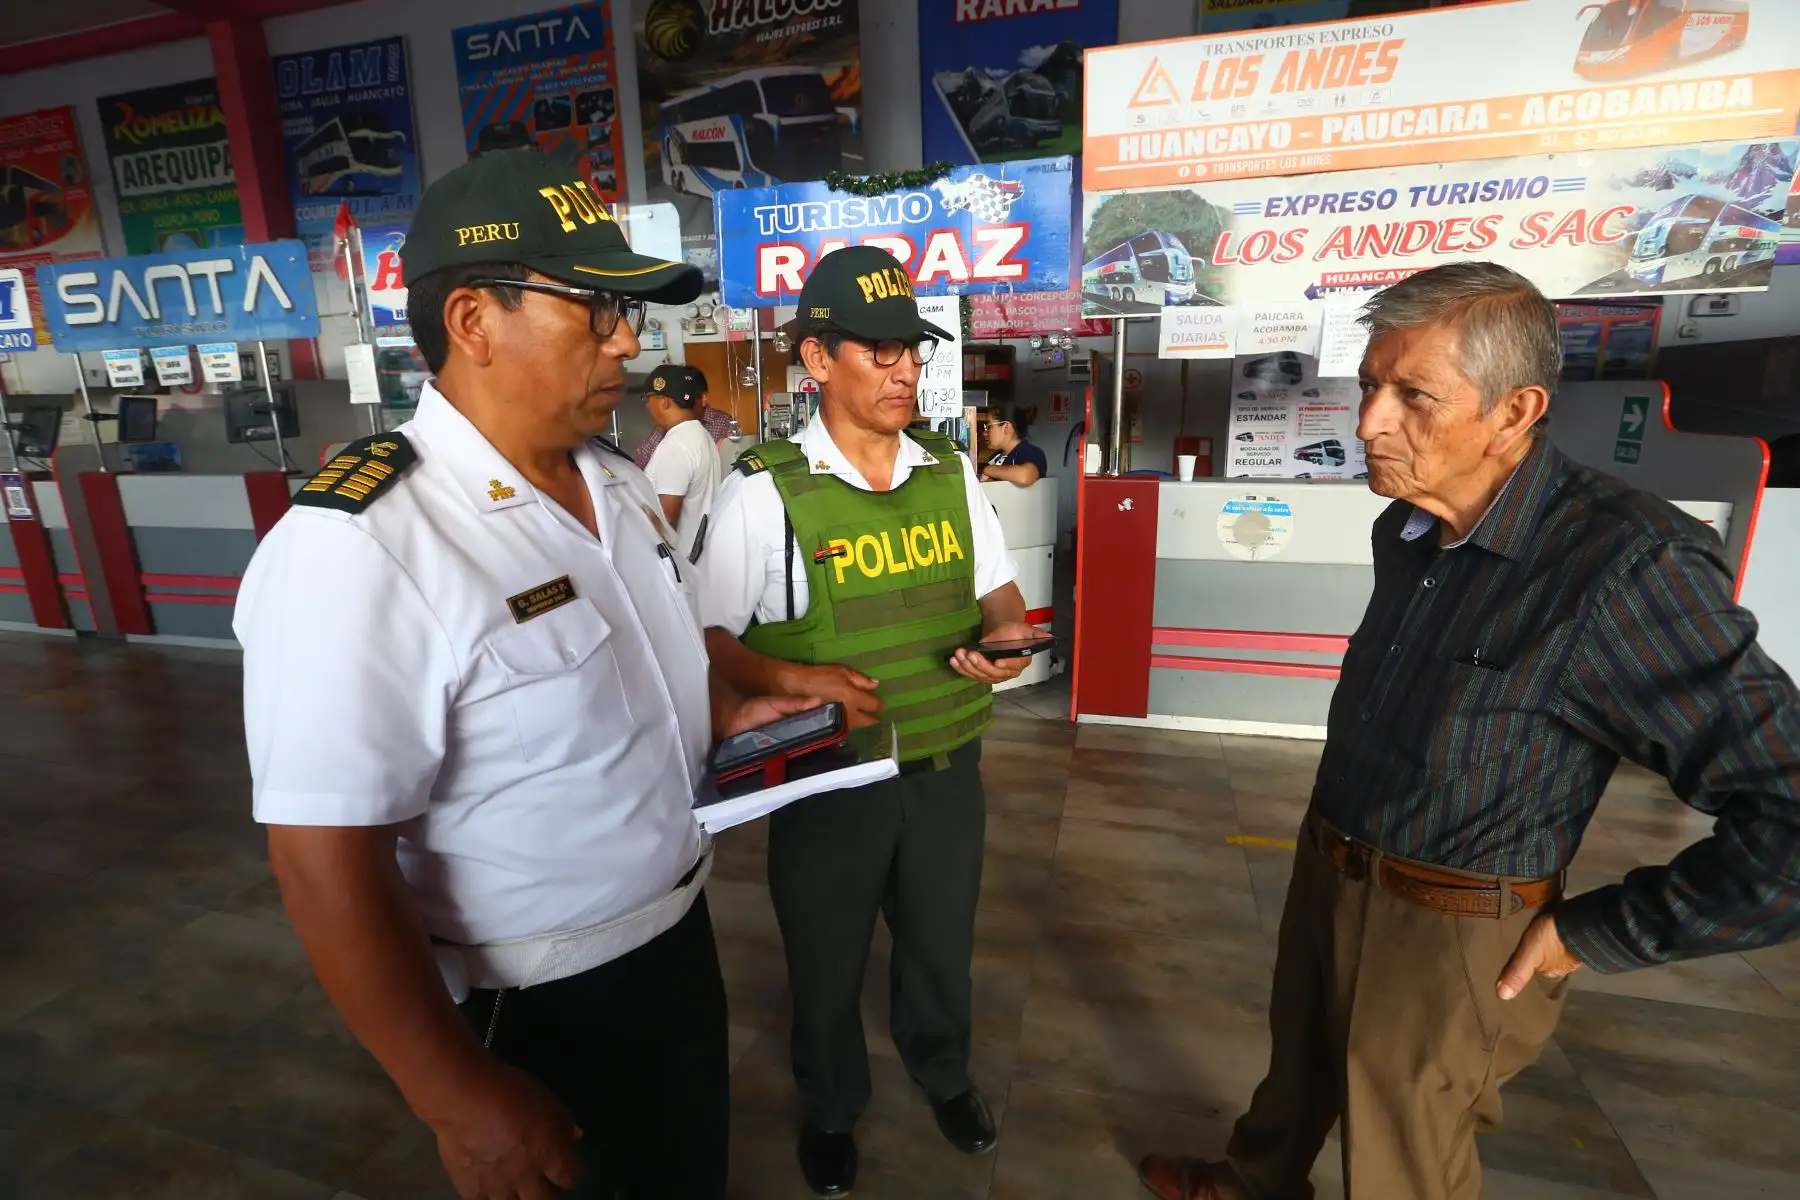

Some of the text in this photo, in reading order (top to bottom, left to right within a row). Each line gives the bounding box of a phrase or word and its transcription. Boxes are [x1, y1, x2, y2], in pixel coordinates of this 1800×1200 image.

[786, 19, 820, 36] EXPRESS
[1204, 23, 1394, 56] TRANSPORTES EXPRESO
[279, 45, 382, 98] OLAM
[1190, 38, 1406, 102] LOS ANDES
[1118, 78, 1754, 162] HUANCAYO PAUCARA ACOBAMBA
[692, 126, 726, 140] HALCON
[1213, 160, 1277, 175] TRANSPORTES
[1280, 157, 1297, 169] LOS
[538, 181, 617, 233] POL
[1264, 176, 1550, 218] EXPRESO TURISMO
[754, 192, 933, 236] TURISMO
[455, 222, 520, 246] PERU
[1212, 204, 1638, 267] LOS ANDES SAC
[57, 255, 293, 325] SANTA
[810, 307, 830, 319] PERU
[919, 305, 944, 314] CAMA
[1006, 306, 1037, 316] PASCO
[1176, 311, 1223, 326] SALIDA
[1254, 311, 1304, 321] PAUCARA
[1170, 331, 1226, 345] DIARIAS
[1252, 324, 1308, 334] ACOBAMBA
[1282, 335, 1297, 344] PM
[919, 387, 956, 412] 10:30
[1235, 458, 1282, 466] REGULAR
[828, 519, 965, 584] POLICIA
